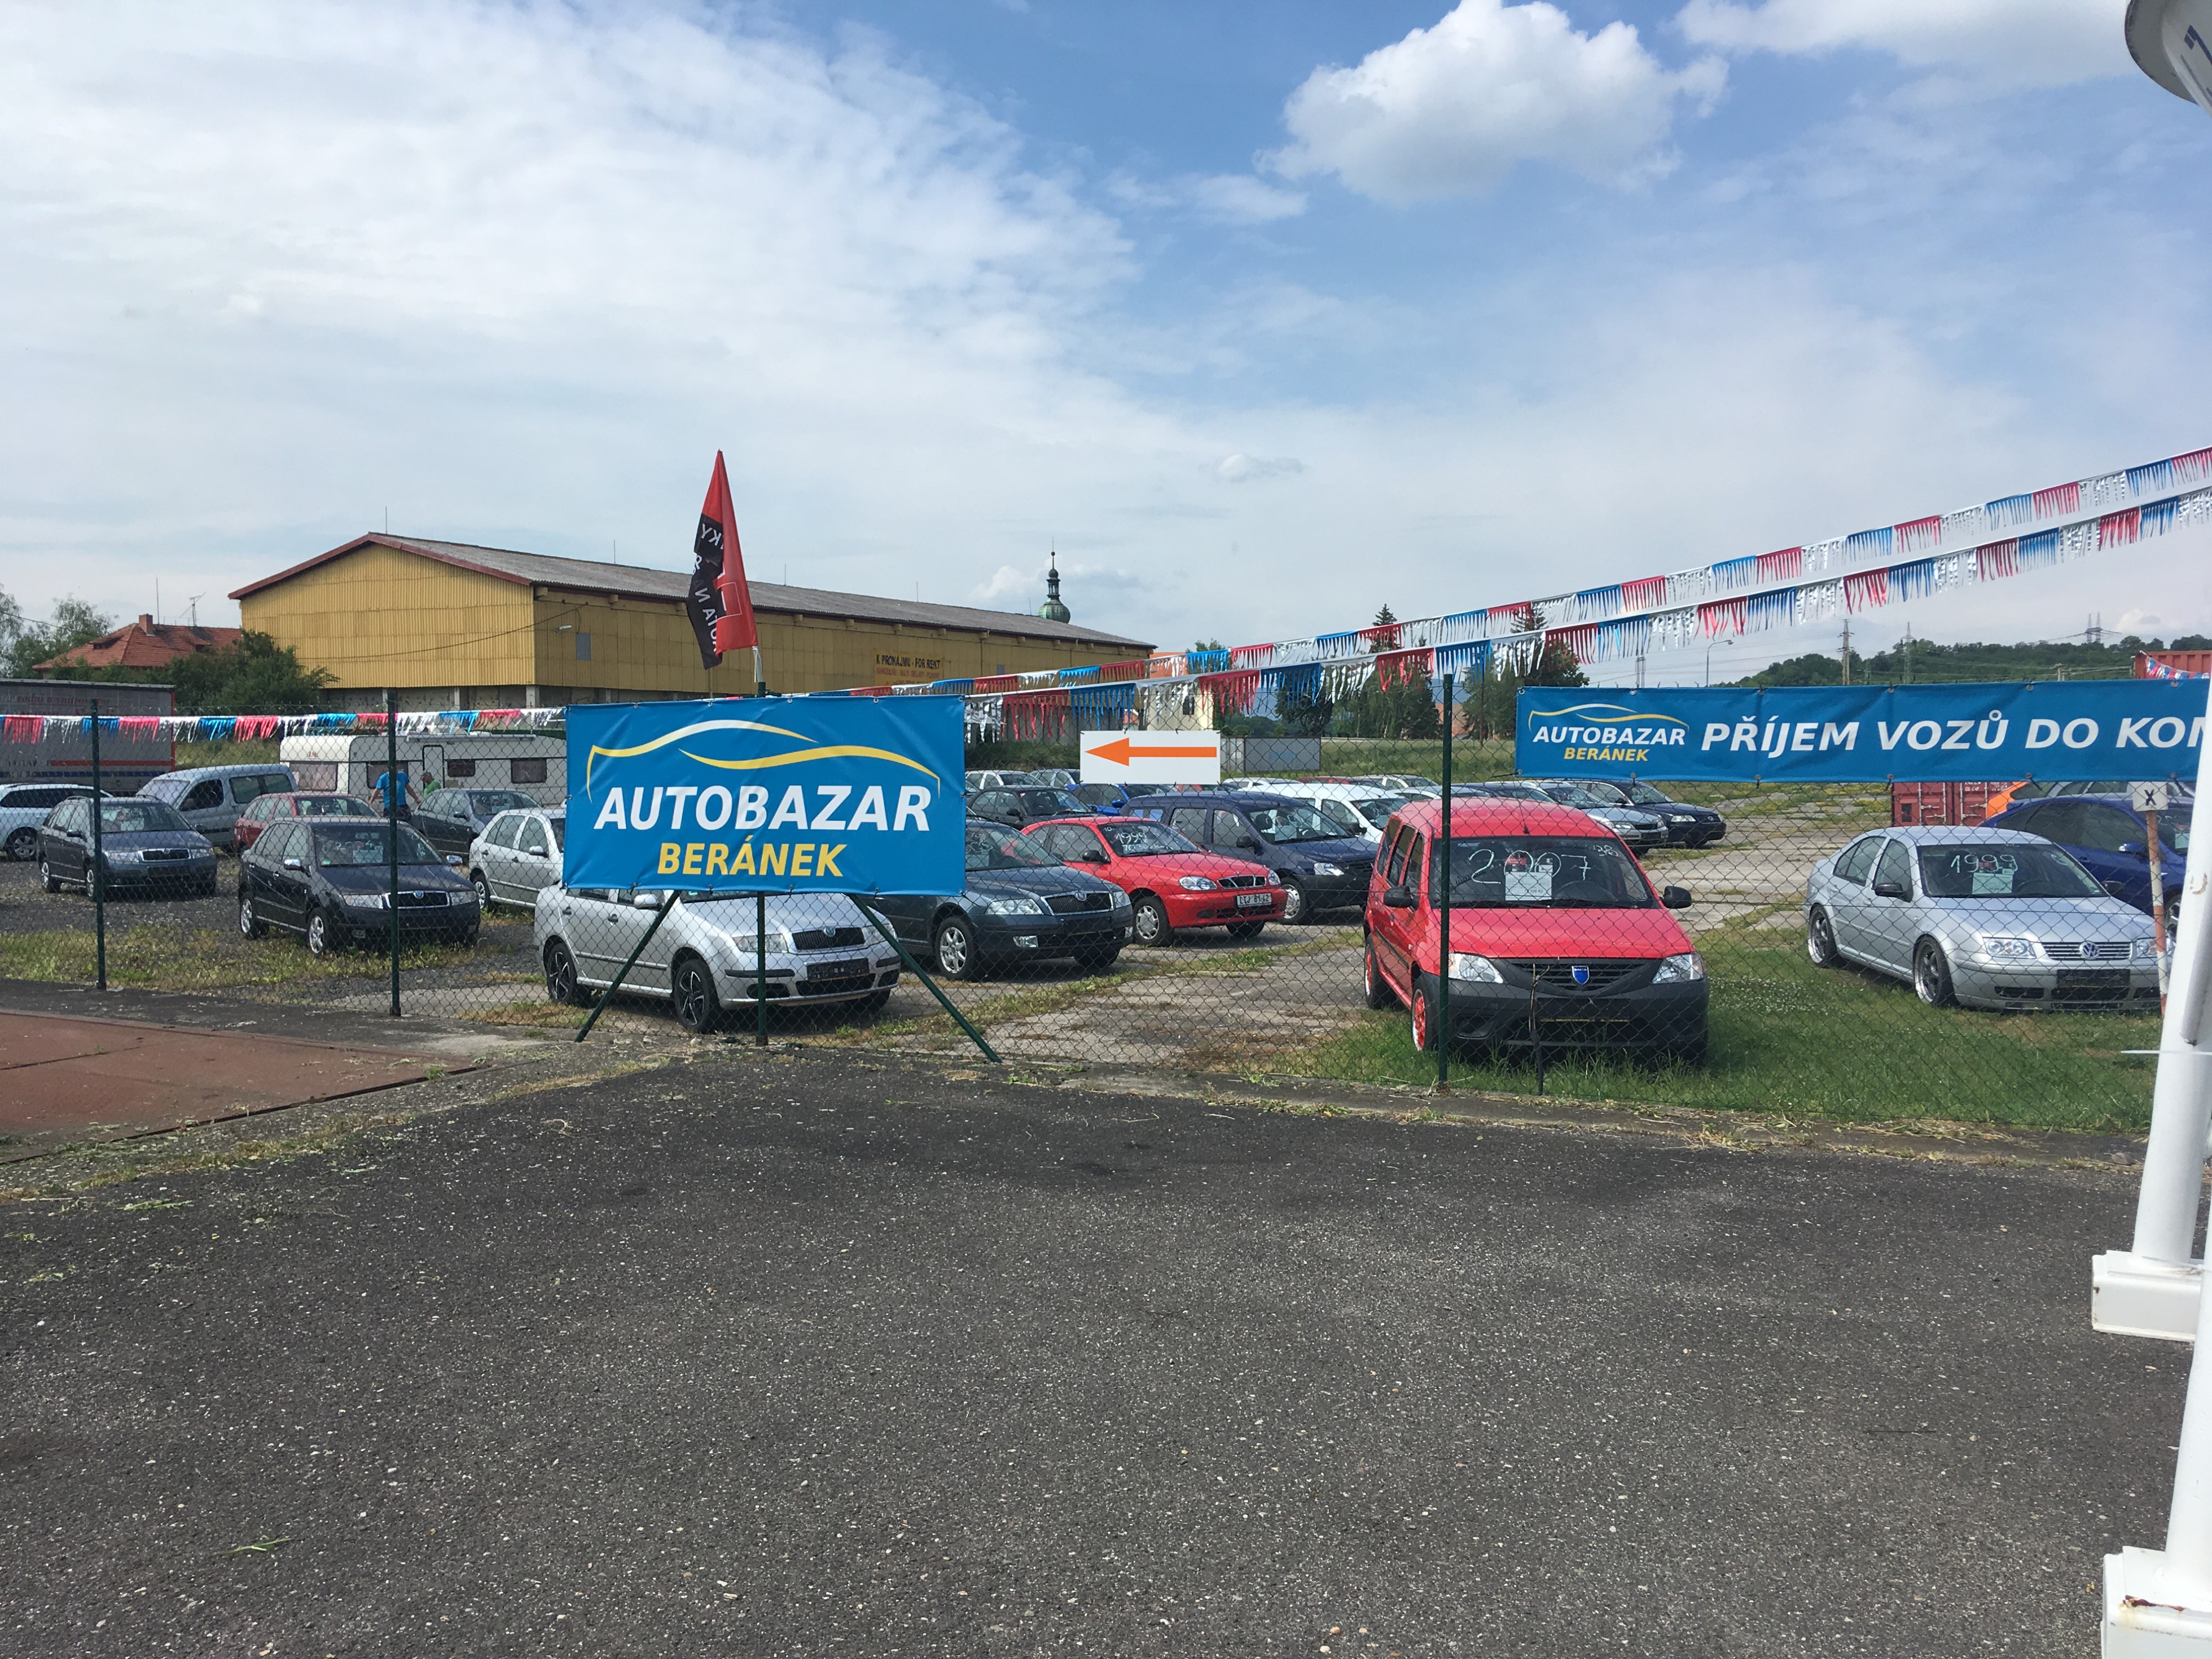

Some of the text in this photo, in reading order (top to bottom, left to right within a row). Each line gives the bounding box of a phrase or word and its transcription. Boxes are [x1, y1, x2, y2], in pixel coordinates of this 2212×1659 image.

[876, 654, 880, 665] K
[915, 658, 926, 669] FOR
[926, 659, 941, 669] RENT
[1532, 726, 1686, 745] AUTOBAZAR
[1701, 715, 1860, 758] PŘÍJEM
[1877, 709, 2008, 750] VOZŮ
[2025, 718, 2099, 749] DO
[1563, 745, 1650, 761] BERÁNEK
[593, 785, 931, 831] AUTOBAZAR
[657, 835, 848, 877] BERÁNEK
[1468, 849, 1592, 889] 2007
[1950, 854, 2018, 873] 1999
